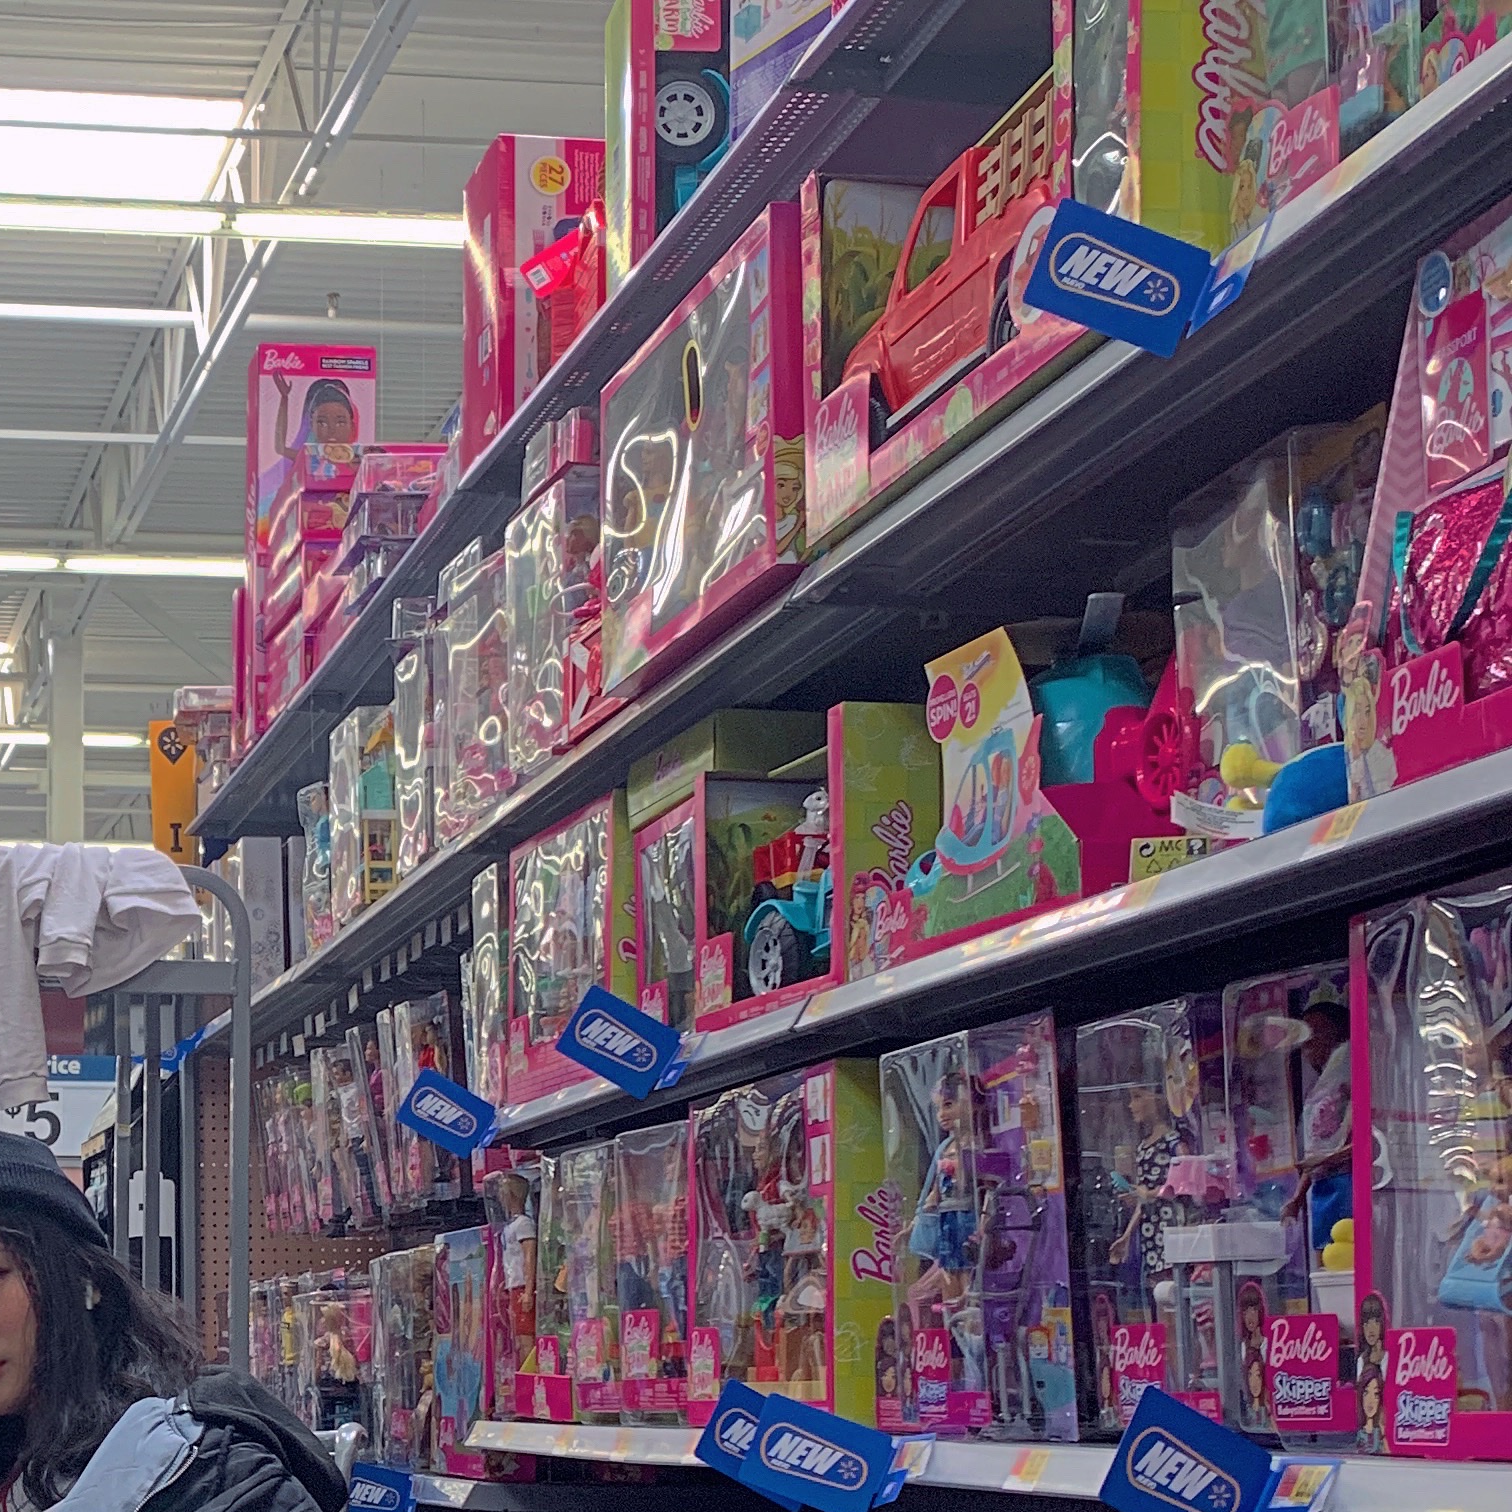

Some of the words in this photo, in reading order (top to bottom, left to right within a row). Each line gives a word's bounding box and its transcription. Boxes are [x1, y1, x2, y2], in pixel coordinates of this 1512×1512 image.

[1195, 0, 1269, 173] arbie
[549, 165, 564, 187] 27
[1059, 245, 1152, 298] NEW
[264, 349, 305, 370] Barbie
[929, 700, 958, 728] SPIN!
[964, 700, 977, 721] 2!
[1391, 660, 1460, 735] Barbie
[170, 823, 183, 852] I
[874, 901, 909, 942] Barbie
[581, 1017, 638, 1055] NEW
[416, 1093, 462, 1125] NEW
[851, 1182, 900, 1284] Barbie
[625, 1313, 653, 1342] Barbie
[1269, 1318, 1334, 1369] Barbie
[915, 1331, 949, 1374] Barbie
[1114, 1327, 1163, 1373] Barbie
[1395, 1331, 1454, 1387] Barbie
[1274, 1371, 1332, 1404] Skipper
[1394, 1390, 1450, 1427] Skipper
[768, 1432, 842, 1476] NEW
[1135, 1441, 1218, 1501] NEW
[350, 1484, 388, 1507] NEW
